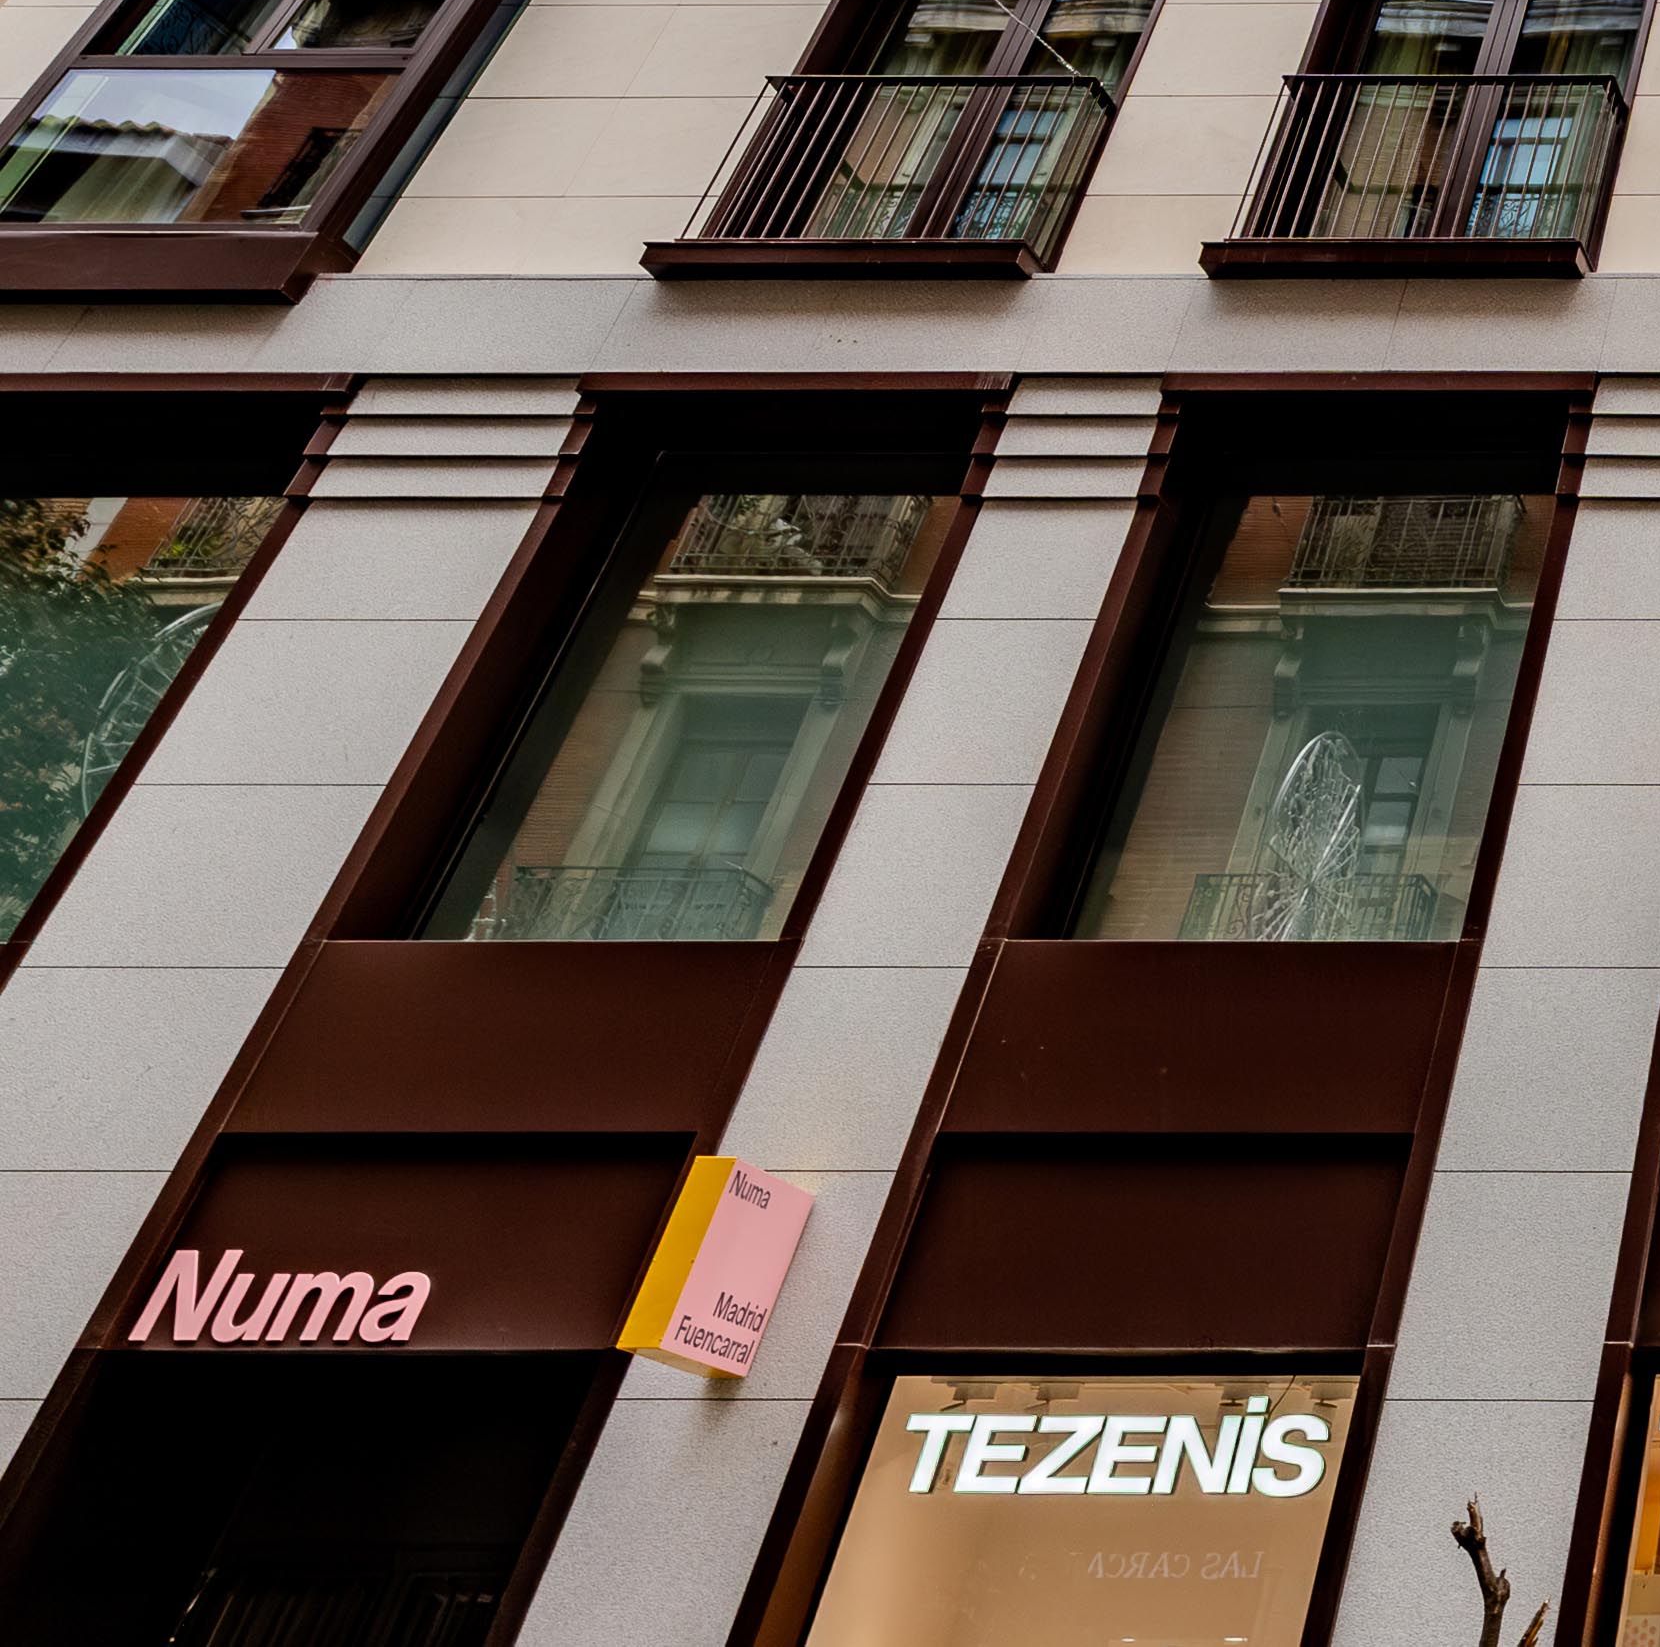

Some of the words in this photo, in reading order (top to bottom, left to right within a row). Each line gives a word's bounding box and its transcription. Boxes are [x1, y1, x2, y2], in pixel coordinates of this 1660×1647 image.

[728, 1169, 771, 1210] Numa
[127, 1249, 432, 1343] Numa
[712, 1291, 768, 1333] Madrid
[674, 1314, 755, 1365] Fuencarral
